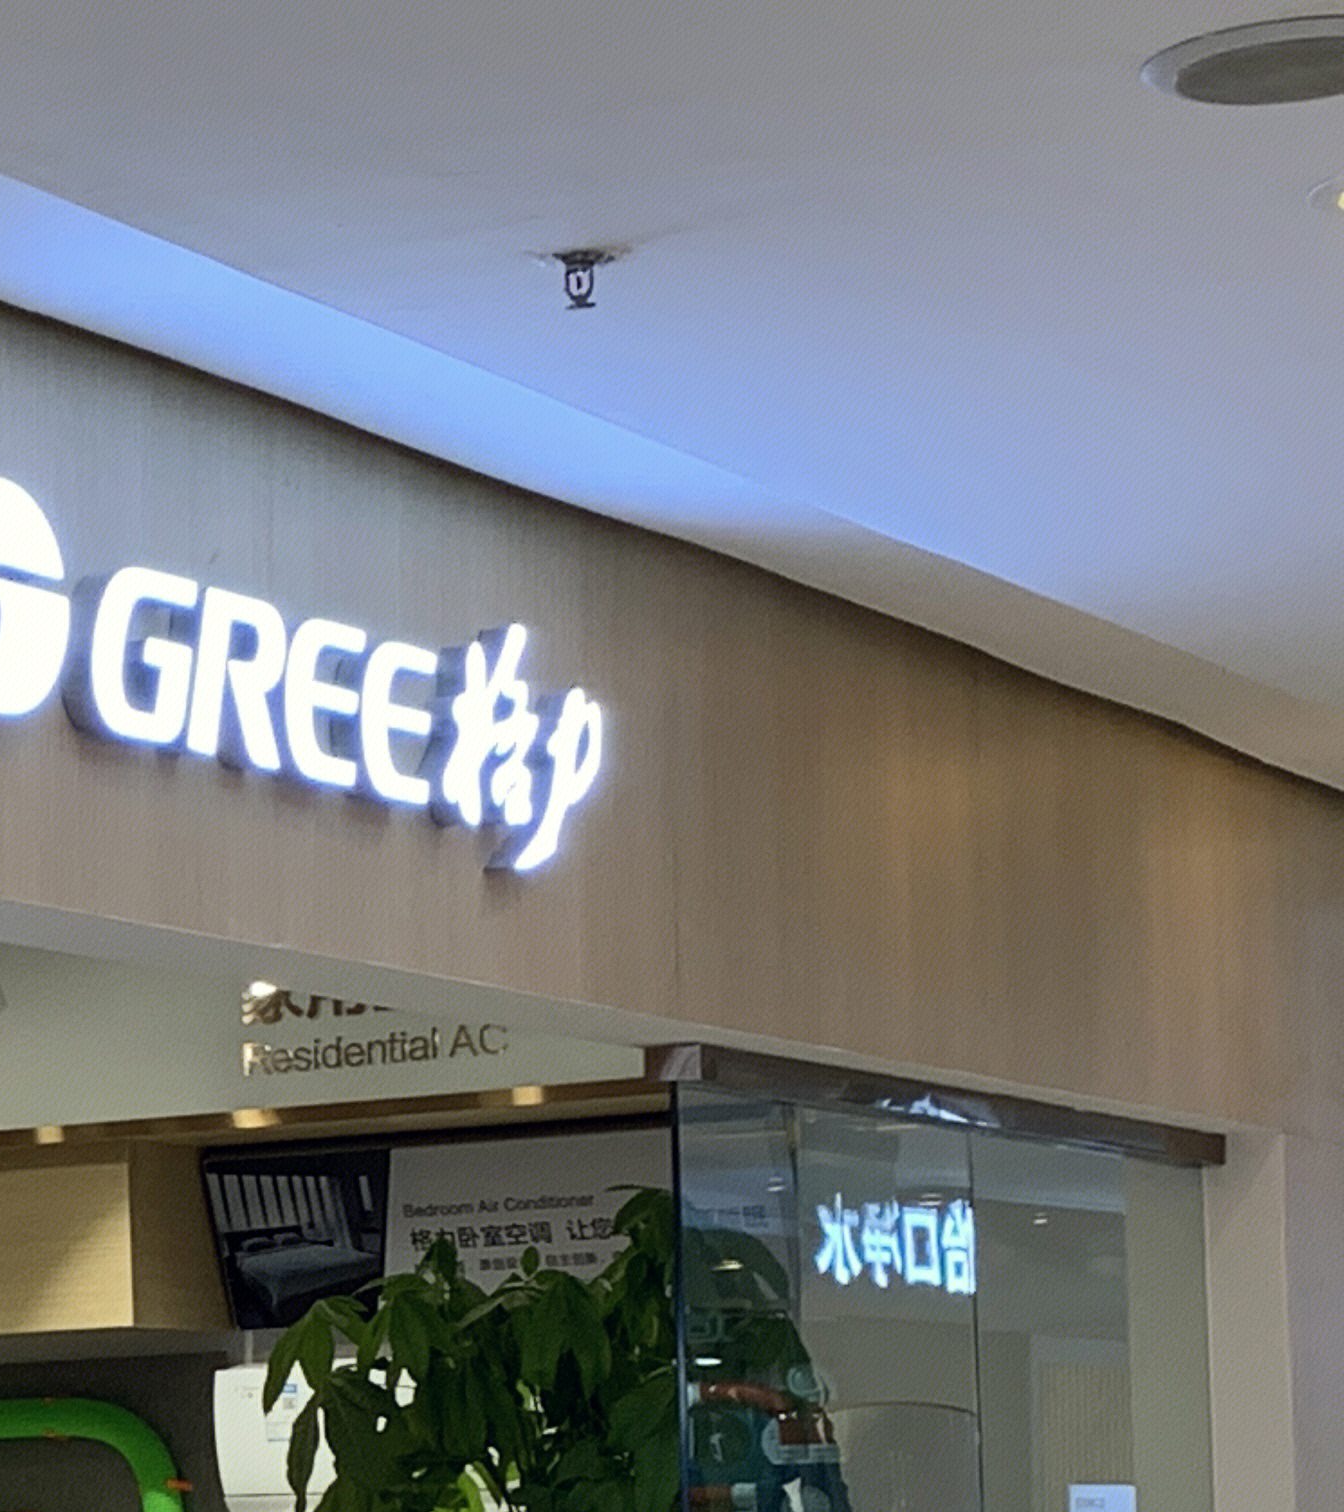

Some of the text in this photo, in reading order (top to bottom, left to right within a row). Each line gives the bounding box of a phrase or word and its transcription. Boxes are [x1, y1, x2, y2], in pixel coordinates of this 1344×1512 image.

[88, 566, 439, 807] GREE
[242, 1022, 509, 1077] Residential AC
[403, 1194, 595, 1218] Bedroom Air Conditioner
